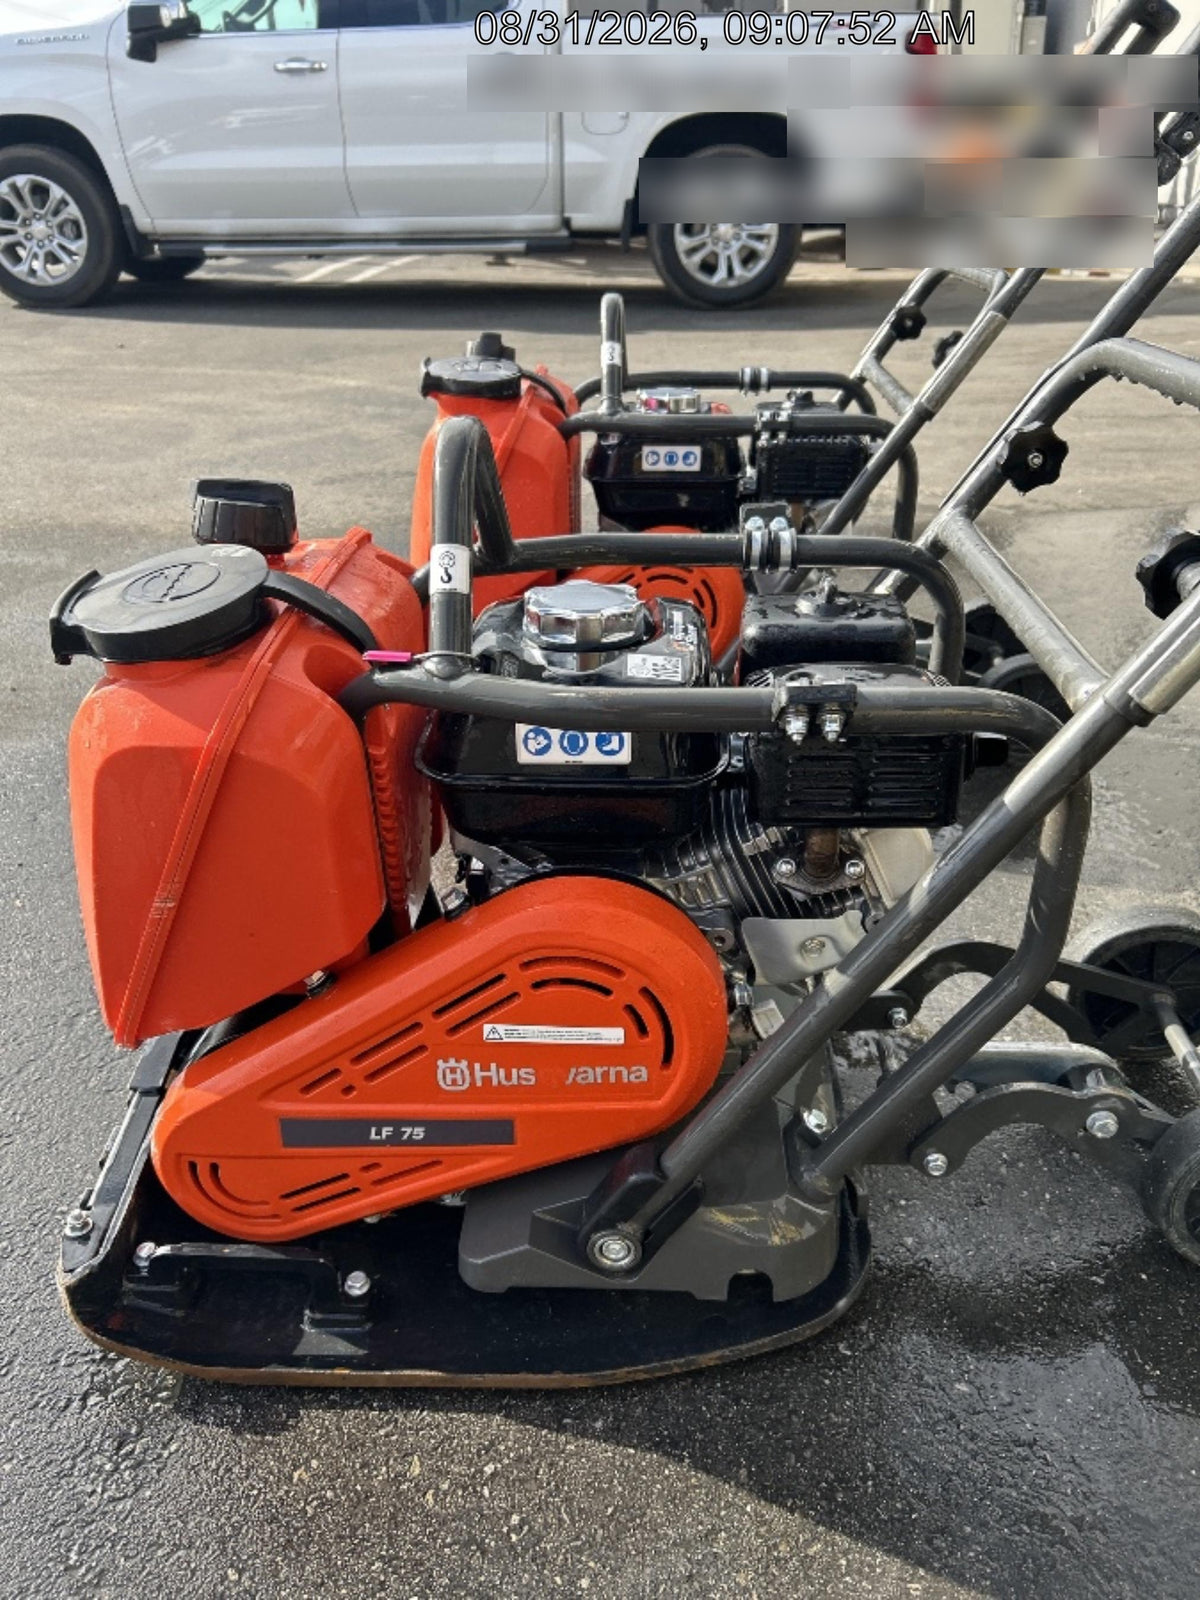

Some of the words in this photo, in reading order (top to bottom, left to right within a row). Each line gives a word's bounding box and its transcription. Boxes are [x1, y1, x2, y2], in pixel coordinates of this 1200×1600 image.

[473, 1062, 649, 1087] Husarna
[369, 1126, 394, 1141] LF
[401, 1126, 426, 1141] 75
